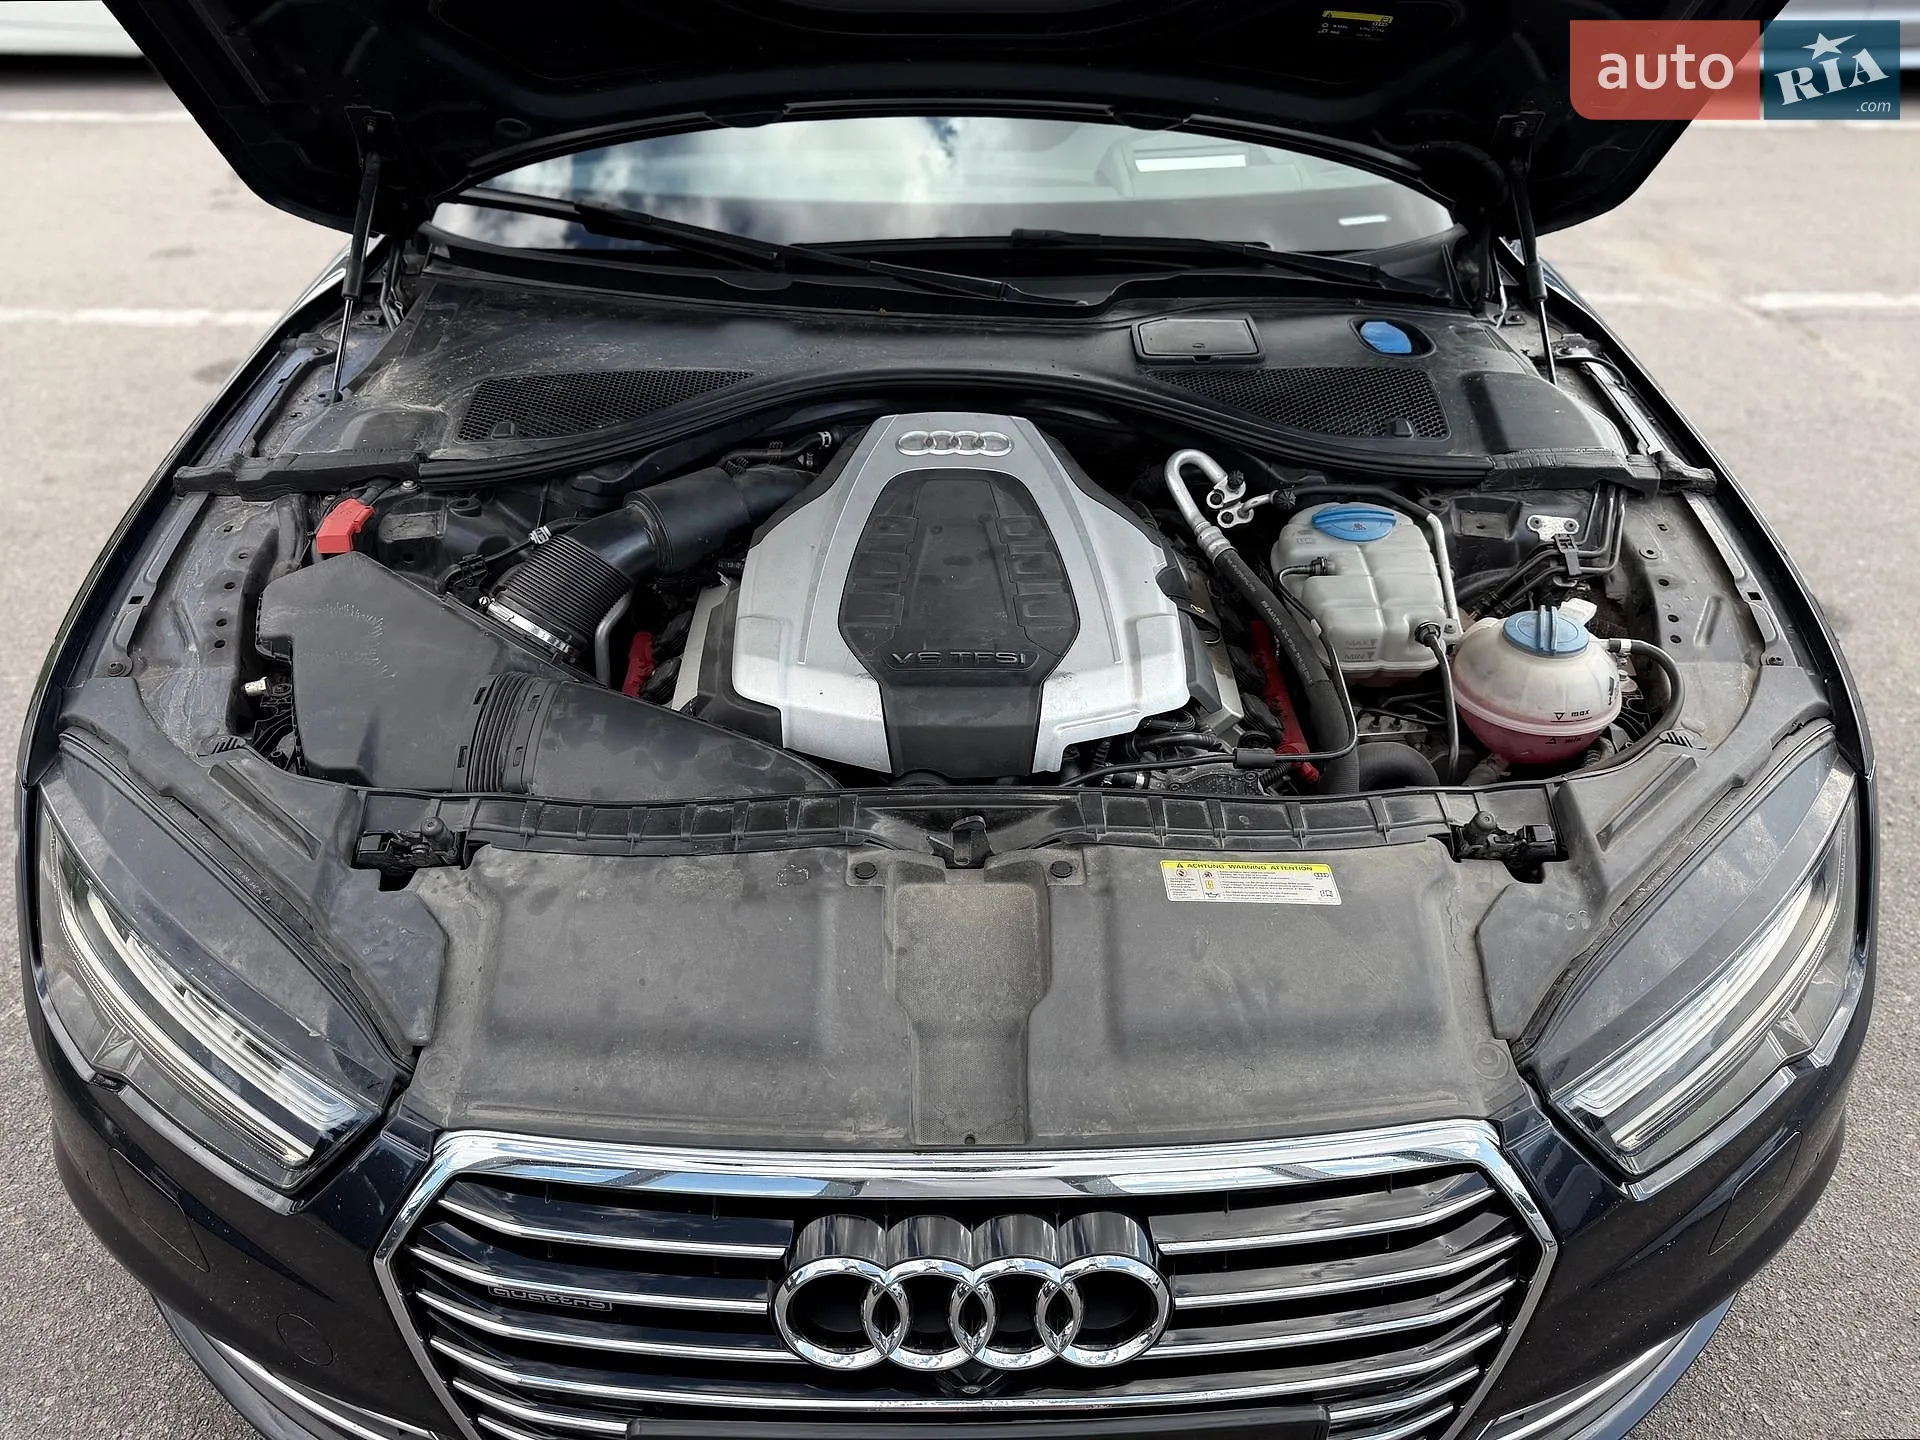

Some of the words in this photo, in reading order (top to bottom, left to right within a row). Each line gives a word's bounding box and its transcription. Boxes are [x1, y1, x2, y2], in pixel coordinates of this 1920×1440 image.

[949, 651, 1026, 665] TFSI
[1571, 709, 1590, 717] max
[493, 1286, 606, 1310] quattro
